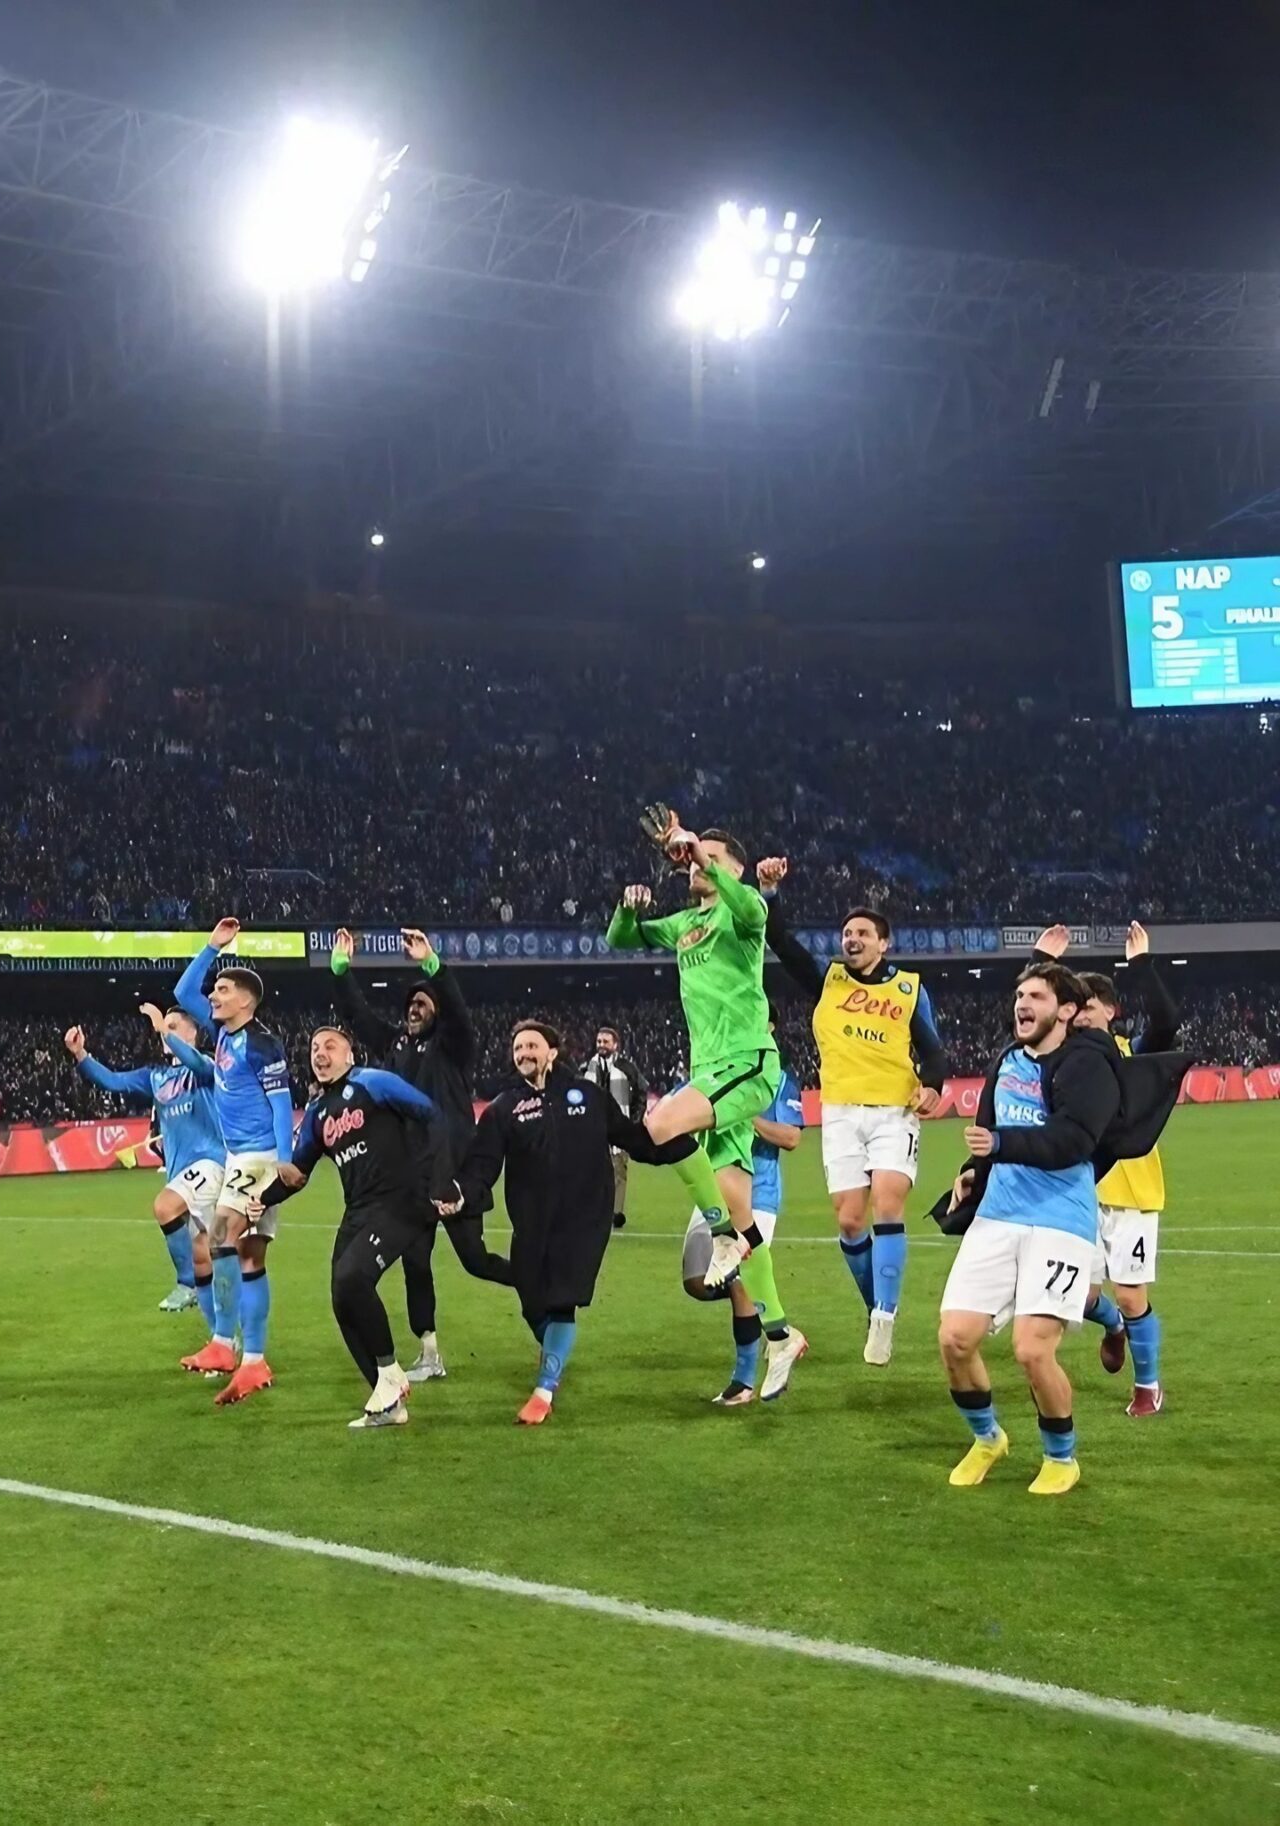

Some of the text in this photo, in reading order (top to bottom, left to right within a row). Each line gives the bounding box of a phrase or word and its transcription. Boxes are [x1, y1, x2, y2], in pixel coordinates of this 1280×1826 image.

[1176, 566, 1231, 590] NAP
[1152, 596, 1183, 639] 5
[310, 932, 337, 950] BLU
[836, 988, 903, 1020] Lete
[1008, 1104, 1048, 1126] MSC
[226, 1169, 257, 1196] 22
[1132, 1236, 1146, 1264] 4
[1045, 1259, 1079, 1294] 77
